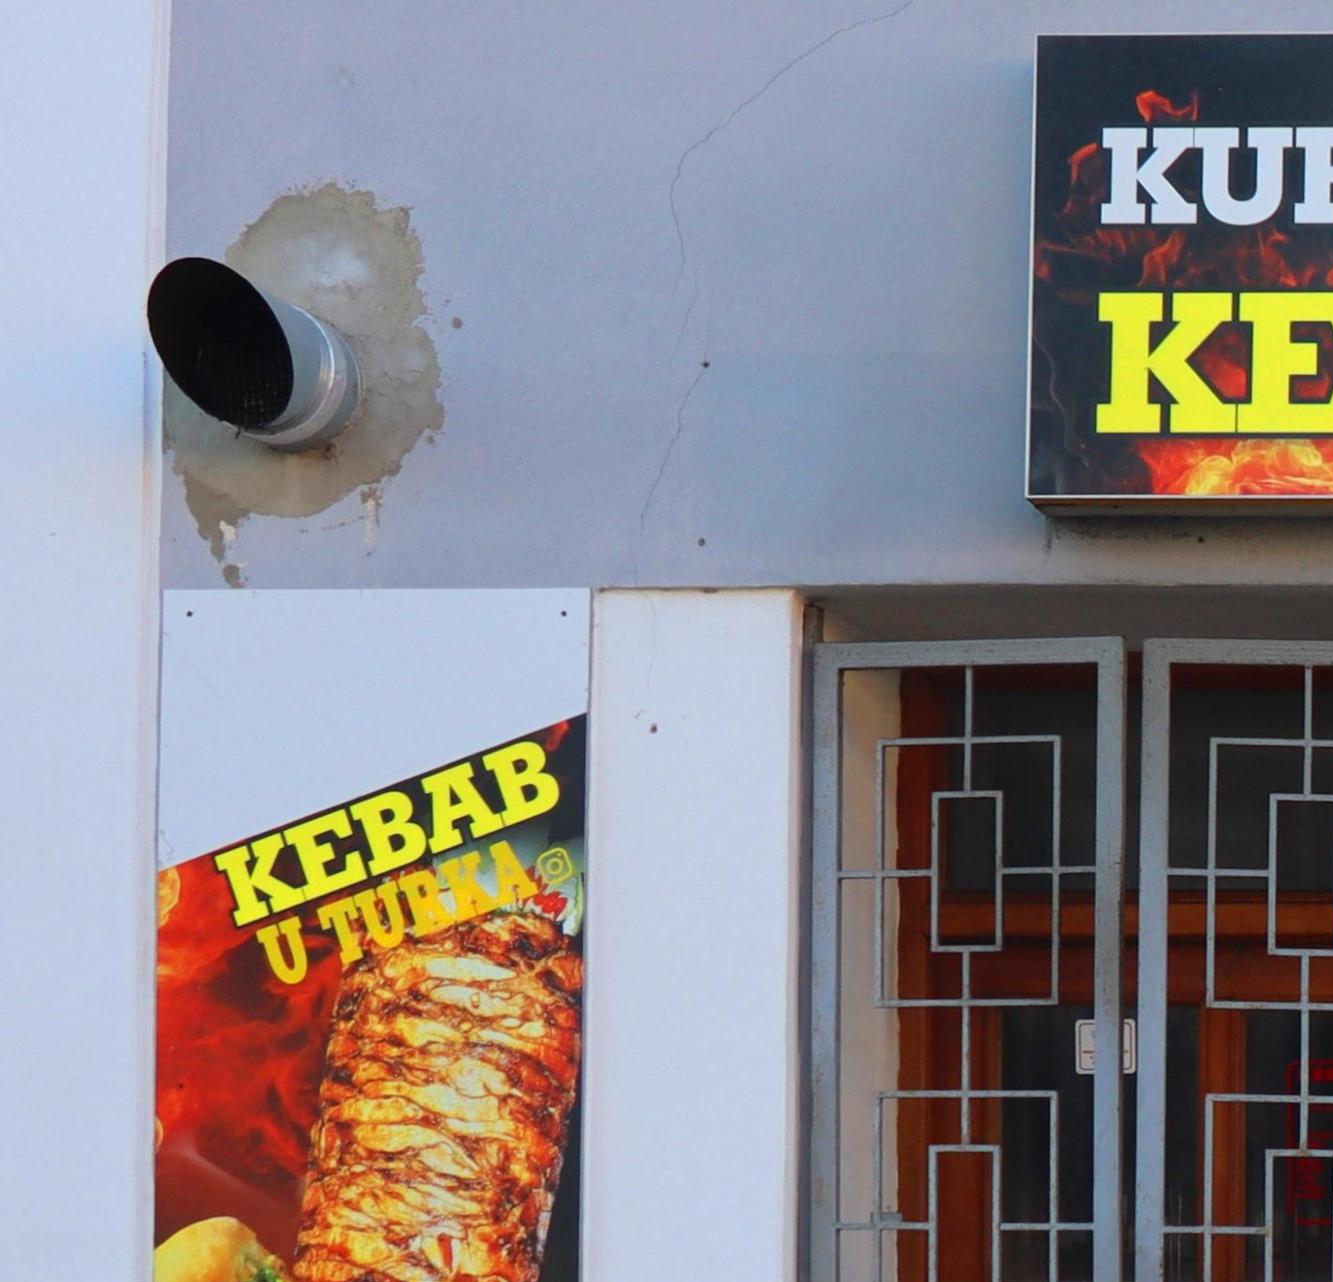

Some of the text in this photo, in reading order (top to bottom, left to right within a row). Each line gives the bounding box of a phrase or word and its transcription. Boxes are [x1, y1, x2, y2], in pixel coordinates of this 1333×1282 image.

[214, 740, 561, 928] KEBAB
[256, 840, 541, 985] U TURKA
